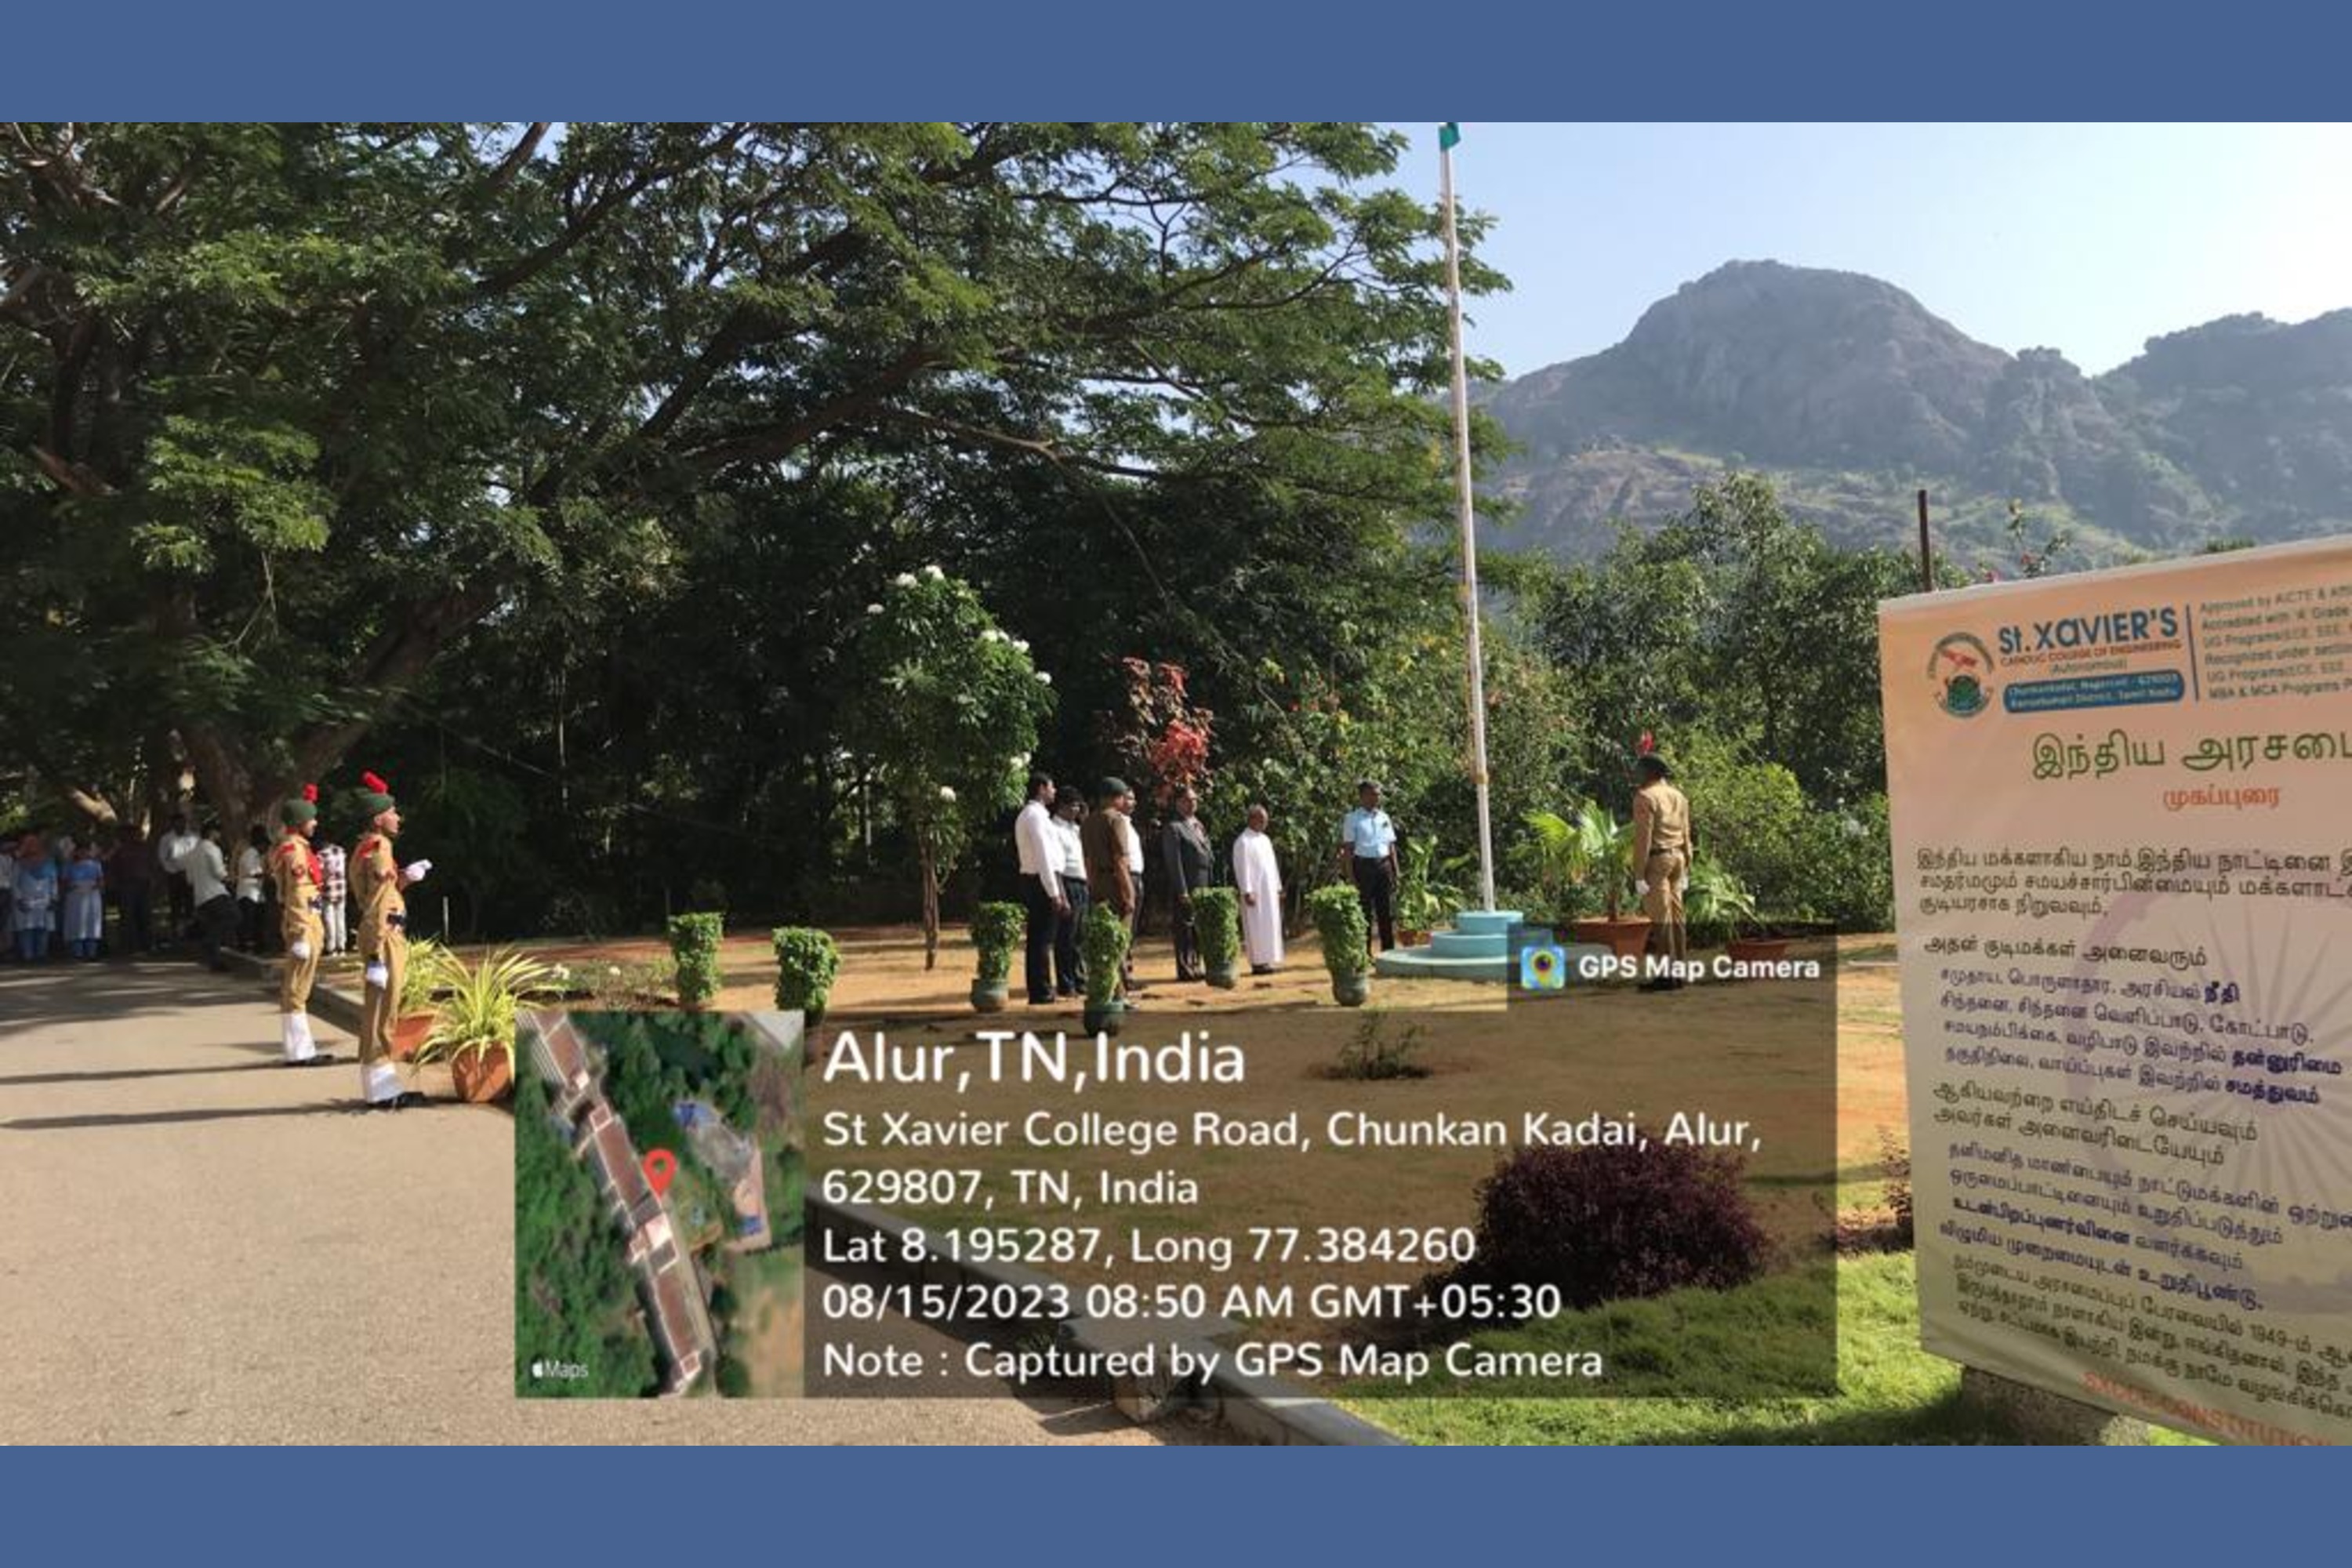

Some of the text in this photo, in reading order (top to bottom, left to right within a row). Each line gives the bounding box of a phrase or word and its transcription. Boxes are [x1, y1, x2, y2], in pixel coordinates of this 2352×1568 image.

[1998, 626, 2031, 655] St.
[2033, 728, 2165, 779] இந்திய
[1917, 847, 1976, 870] இந்திய
[1984, 847, 2086, 867] மக்களாகிய
[2138, 847, 2209, 873] இந்திய
[2218, 850, 2330, 875] நாட்டினை
[1924, 935, 1977, 955] அதன்
